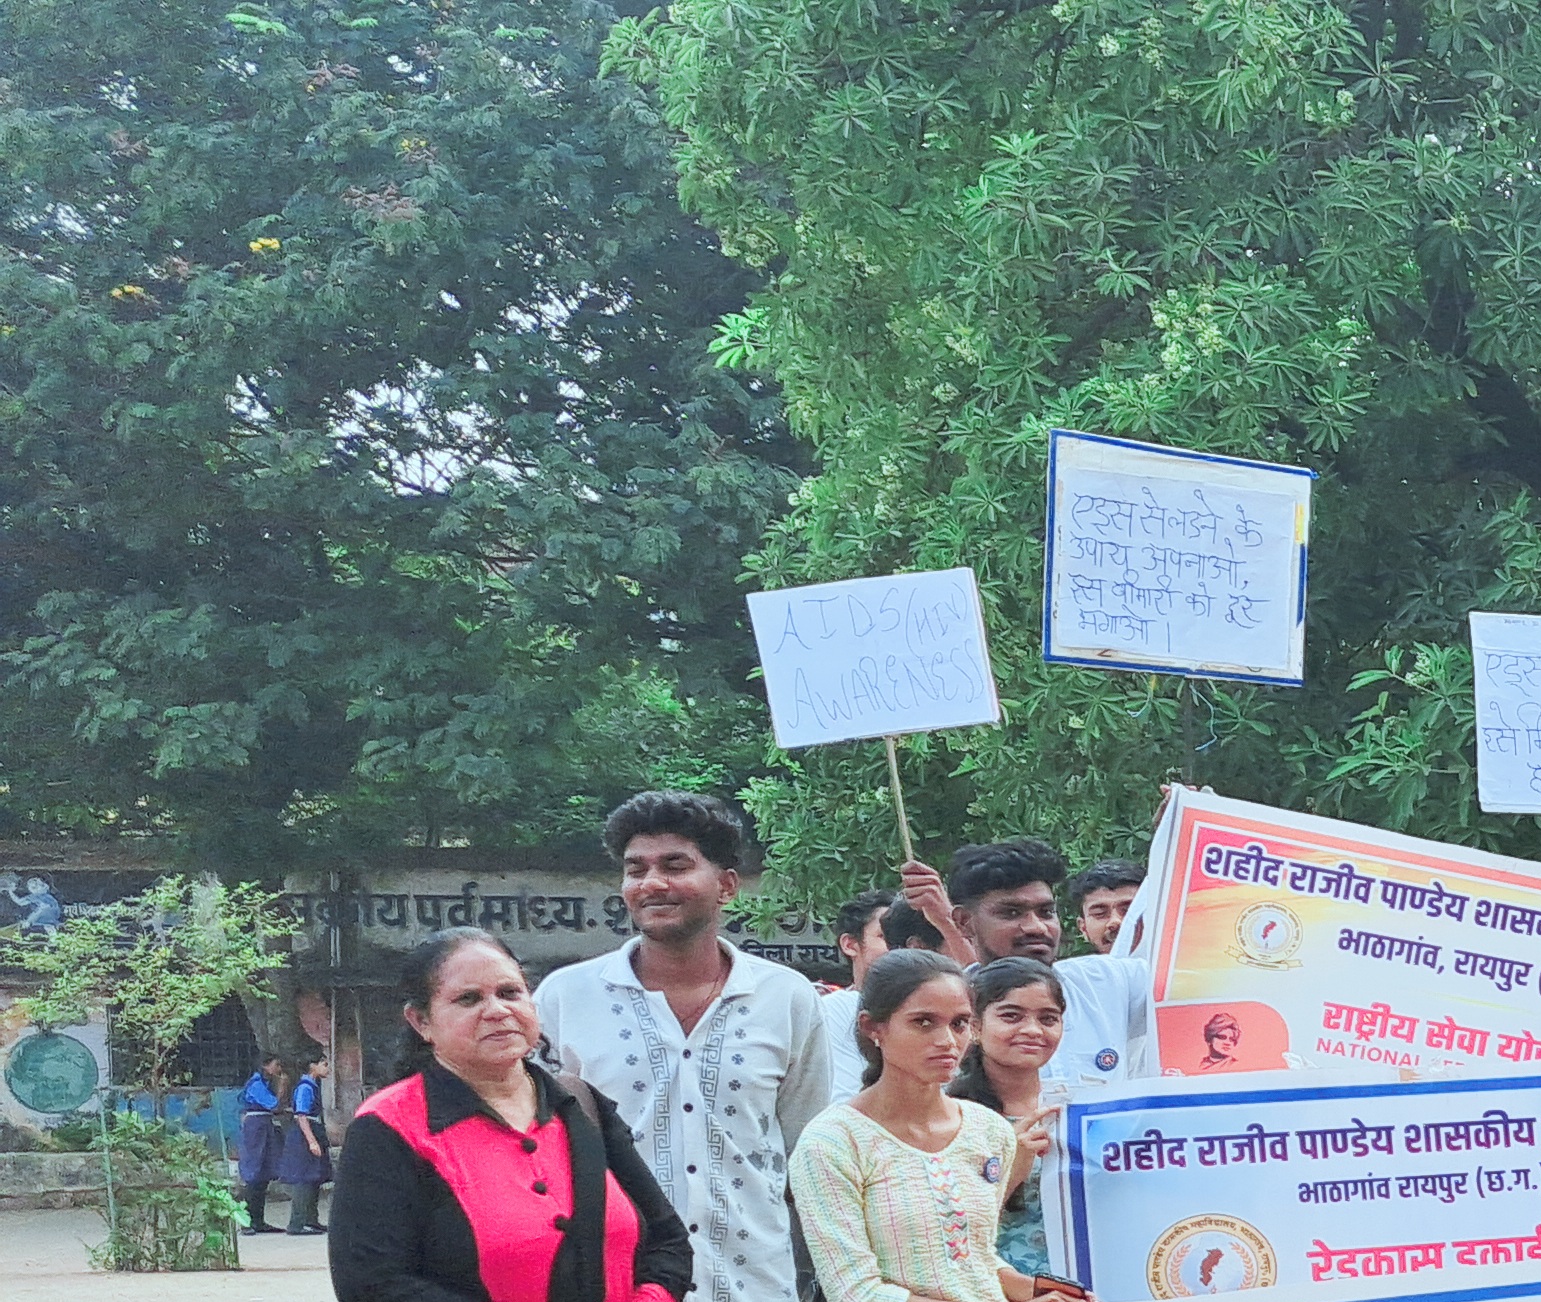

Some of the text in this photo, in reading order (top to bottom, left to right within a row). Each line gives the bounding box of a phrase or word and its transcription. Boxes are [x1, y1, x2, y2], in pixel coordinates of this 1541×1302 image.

[786, 638, 984, 730] AWARENESS
[1204, 844, 1285, 886] शहीद
[1288, 863, 1376, 905] राजीव
[1380, 881, 1470, 922] पाण्डेय
[1337, 927, 1445, 975] भाठागांव,
[1454, 949, 1534, 992] रायपुर
[1322, 1000, 1420, 1043] राष्ट्रीय
[1425, 1015, 1491, 1058] सेवा
[1102, 1128, 1188, 1172] शहीद
[1193, 1122, 1291, 1166] राजीव
[1295, 1117, 1395, 1160] पाण्डेय
[1404, 1108, 1537, 1154] शासकीय
[1298, 1171, 1392, 1204] भाठागांव
[1395, 1171, 1469, 1204] रायपुर
